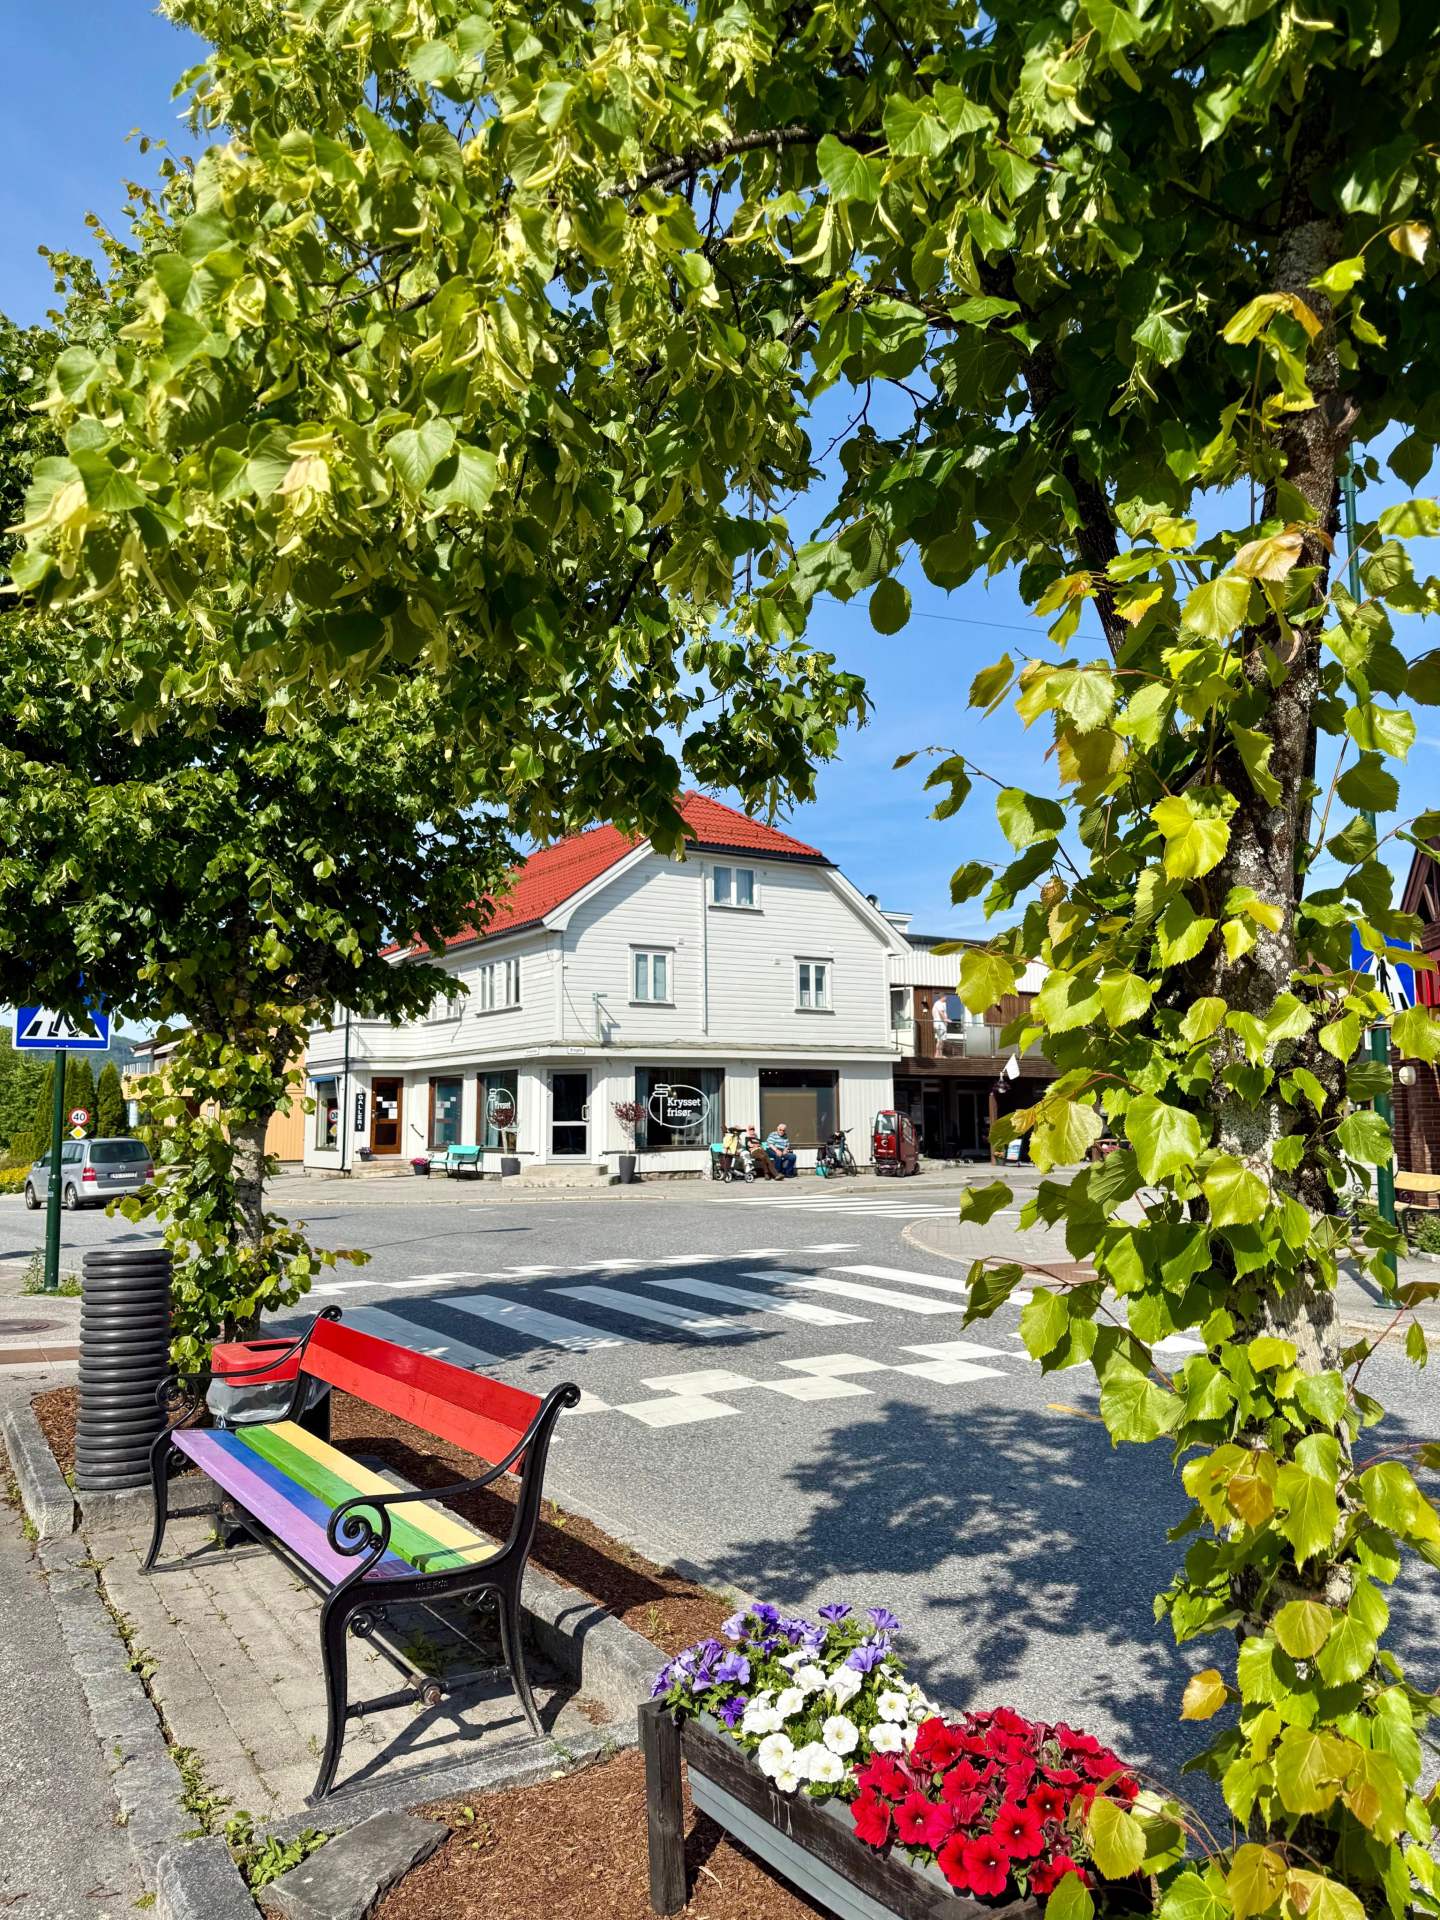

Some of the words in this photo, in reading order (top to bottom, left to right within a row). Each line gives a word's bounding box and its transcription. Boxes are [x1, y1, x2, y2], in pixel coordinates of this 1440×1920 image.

[667, 1097, 701, 1108] Krysset
[73, 1112, 86, 1121] 40
[667, 1108, 692, 1117] frisør
